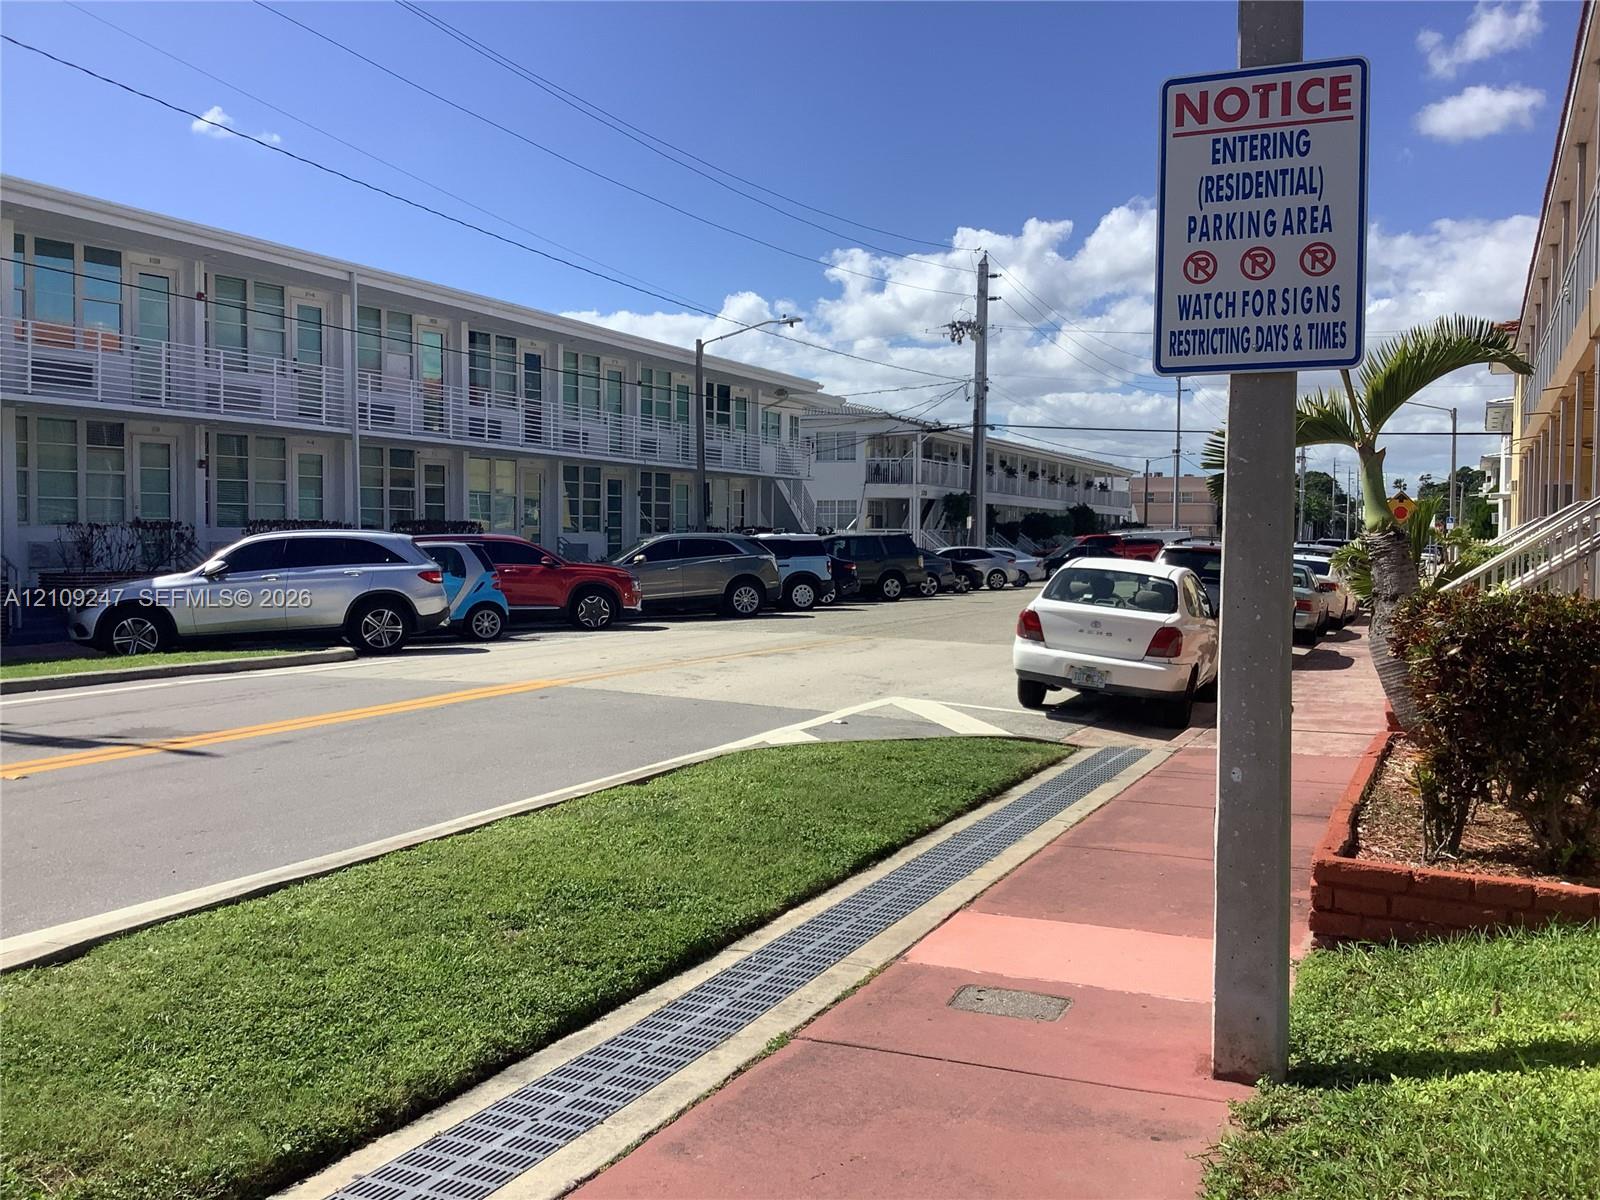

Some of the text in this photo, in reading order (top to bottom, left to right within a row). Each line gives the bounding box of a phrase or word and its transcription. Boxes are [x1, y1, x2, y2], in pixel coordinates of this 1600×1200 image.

[1175, 74, 1352, 128] NOTICE
[1211, 129, 1311, 165] ENTERING
[1199, 166, 1323, 210] (RESIDENTIAL)
[1188, 205, 1333, 243] PARKING AREA
[1177, 284, 1341, 321] WATCH FOR SIGNS
[1169, 321, 1347, 357] RESTRICTING DAYS & TIMES
